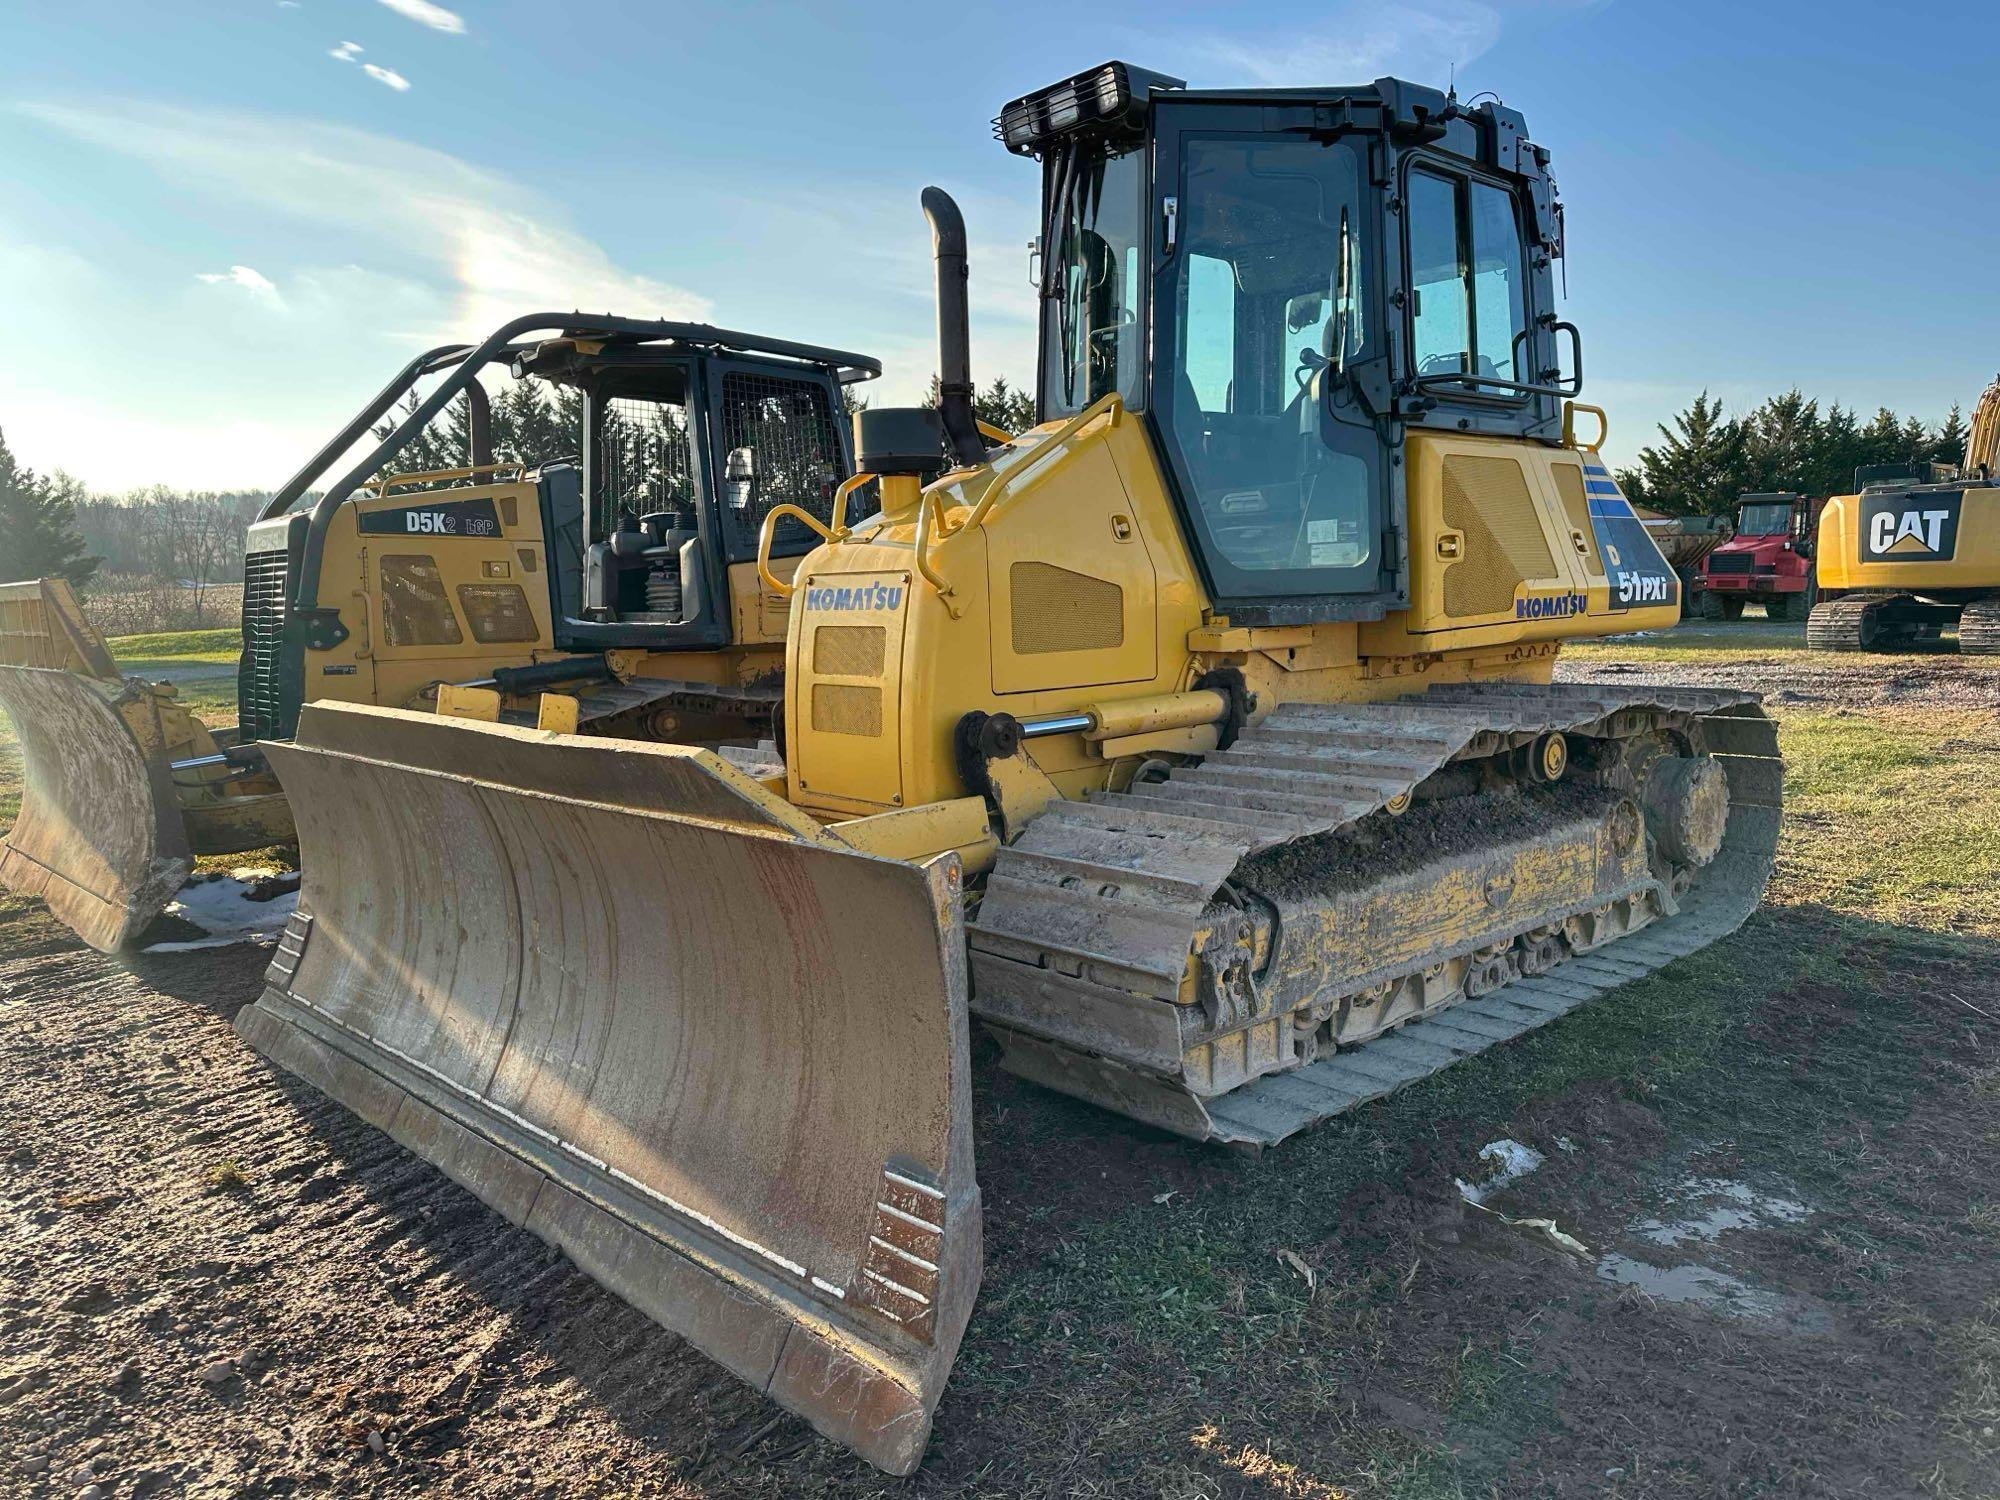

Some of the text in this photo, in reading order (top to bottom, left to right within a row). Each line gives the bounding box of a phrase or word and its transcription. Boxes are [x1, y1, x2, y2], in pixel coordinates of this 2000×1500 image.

[465, 518, 494, 535] LGP
[1869, 509, 1949, 554] CAT
[806, 581, 902, 611] KOMATSU
[1516, 590, 1587, 618] KOMATSU
